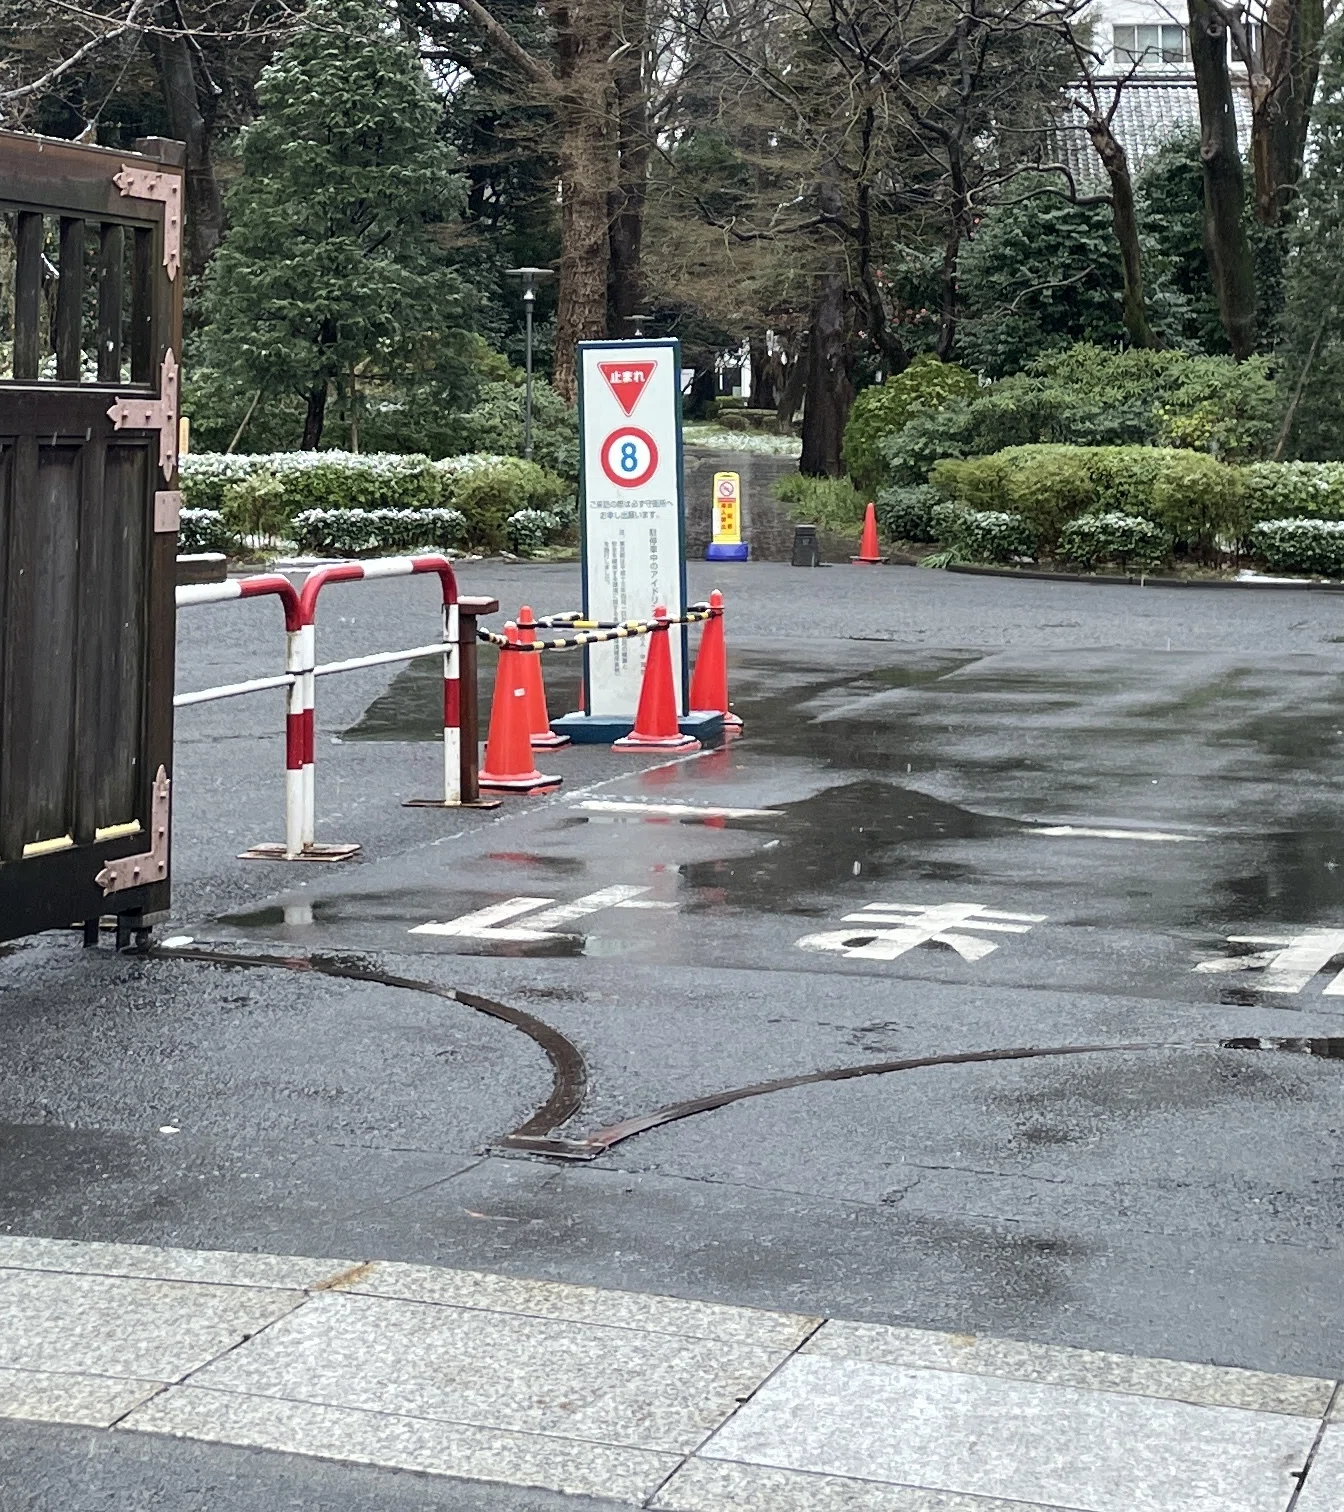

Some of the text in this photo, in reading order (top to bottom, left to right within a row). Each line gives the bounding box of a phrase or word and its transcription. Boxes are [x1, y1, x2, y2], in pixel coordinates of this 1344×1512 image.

[610, 370, 646, 384] 止まれ
[621, 442, 638, 472] 8
